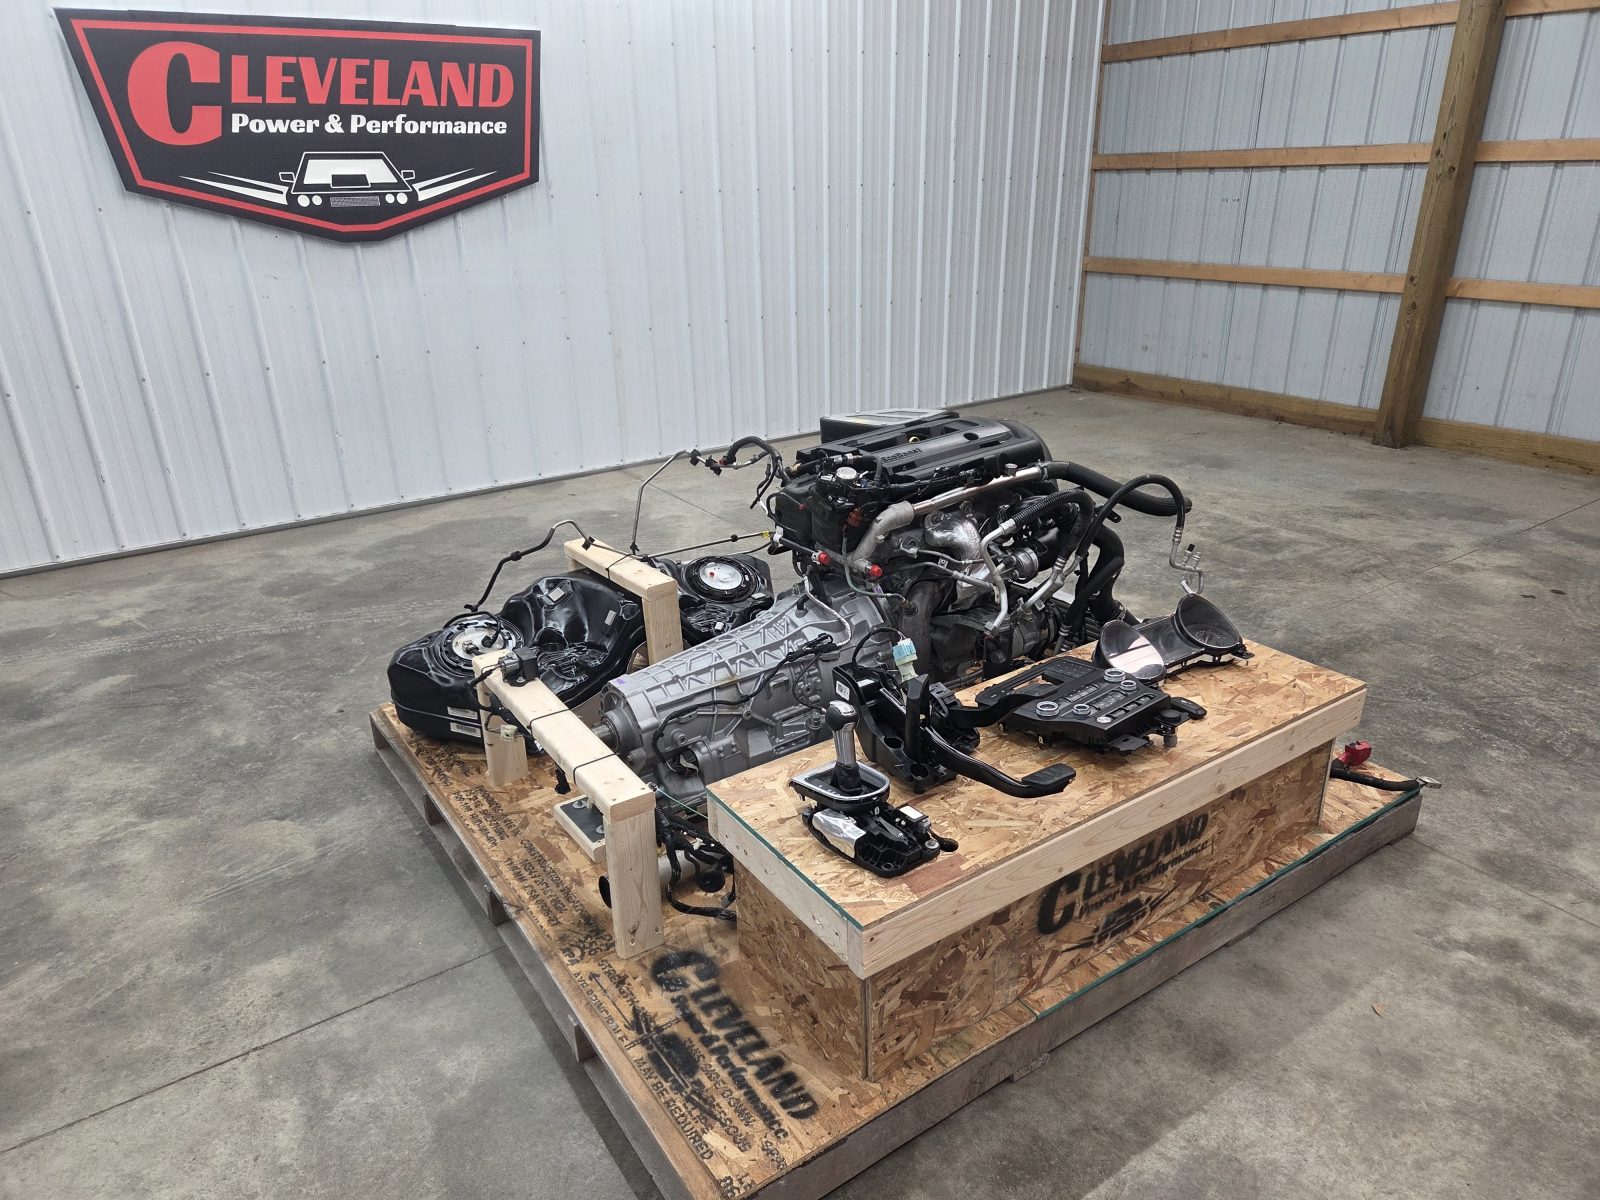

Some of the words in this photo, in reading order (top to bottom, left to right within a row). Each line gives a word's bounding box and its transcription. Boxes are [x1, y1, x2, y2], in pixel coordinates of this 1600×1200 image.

[127, 41, 514, 145] CLEVELAND
[231, 113, 319, 134] Power
[323, 114, 345, 134] &
[350, 114, 508, 135] Performance
[634, 1057, 659, 1084] MAY
[652, 1080, 670, 1100] BE
